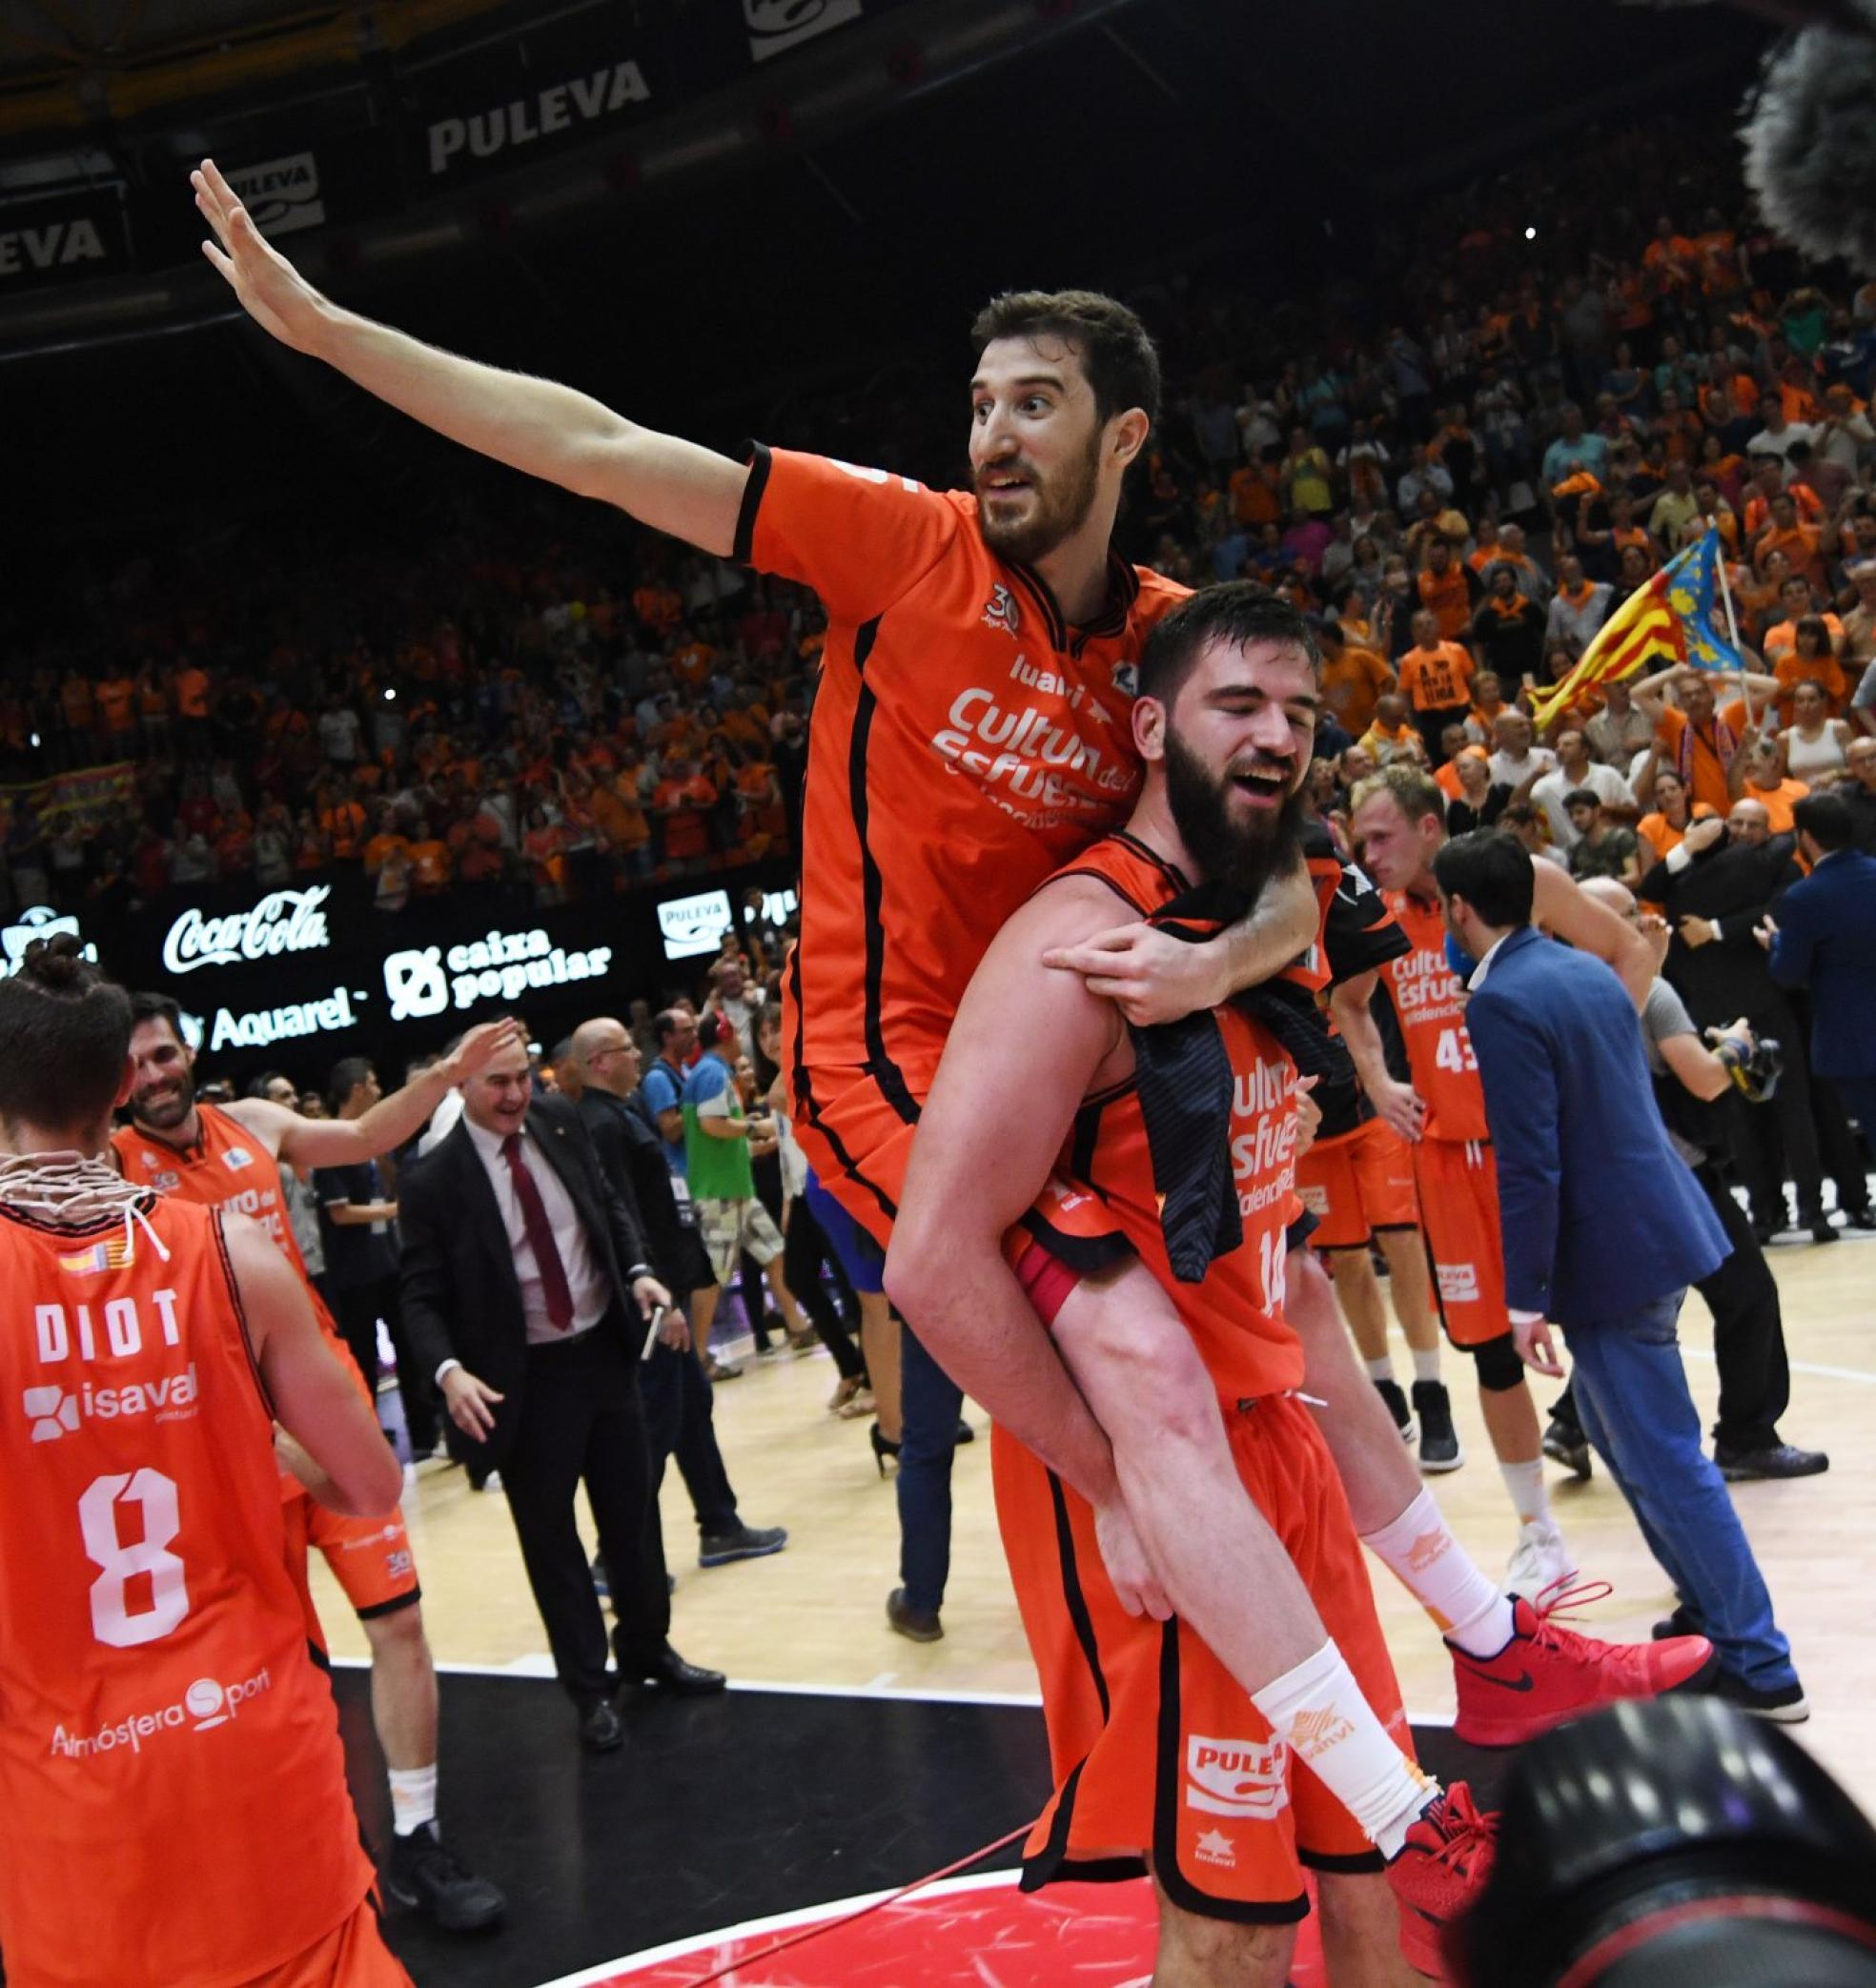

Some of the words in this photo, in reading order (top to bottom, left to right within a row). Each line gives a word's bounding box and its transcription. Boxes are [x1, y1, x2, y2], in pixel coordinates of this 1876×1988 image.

[428, 59, 651, 174] PULEVA
[231, 165, 310, 196] ULEVA
[163, 884, 331, 974] Coca-Cola
[666, 903, 722, 923] PULEVA
[447, 929, 551, 972] caixa
[451, 946, 612, 1009] popular
[210, 986, 357, 1052] Aquarel
[34, 1288, 180, 1363] DIOT
[78, 1468, 190, 1648] 8
